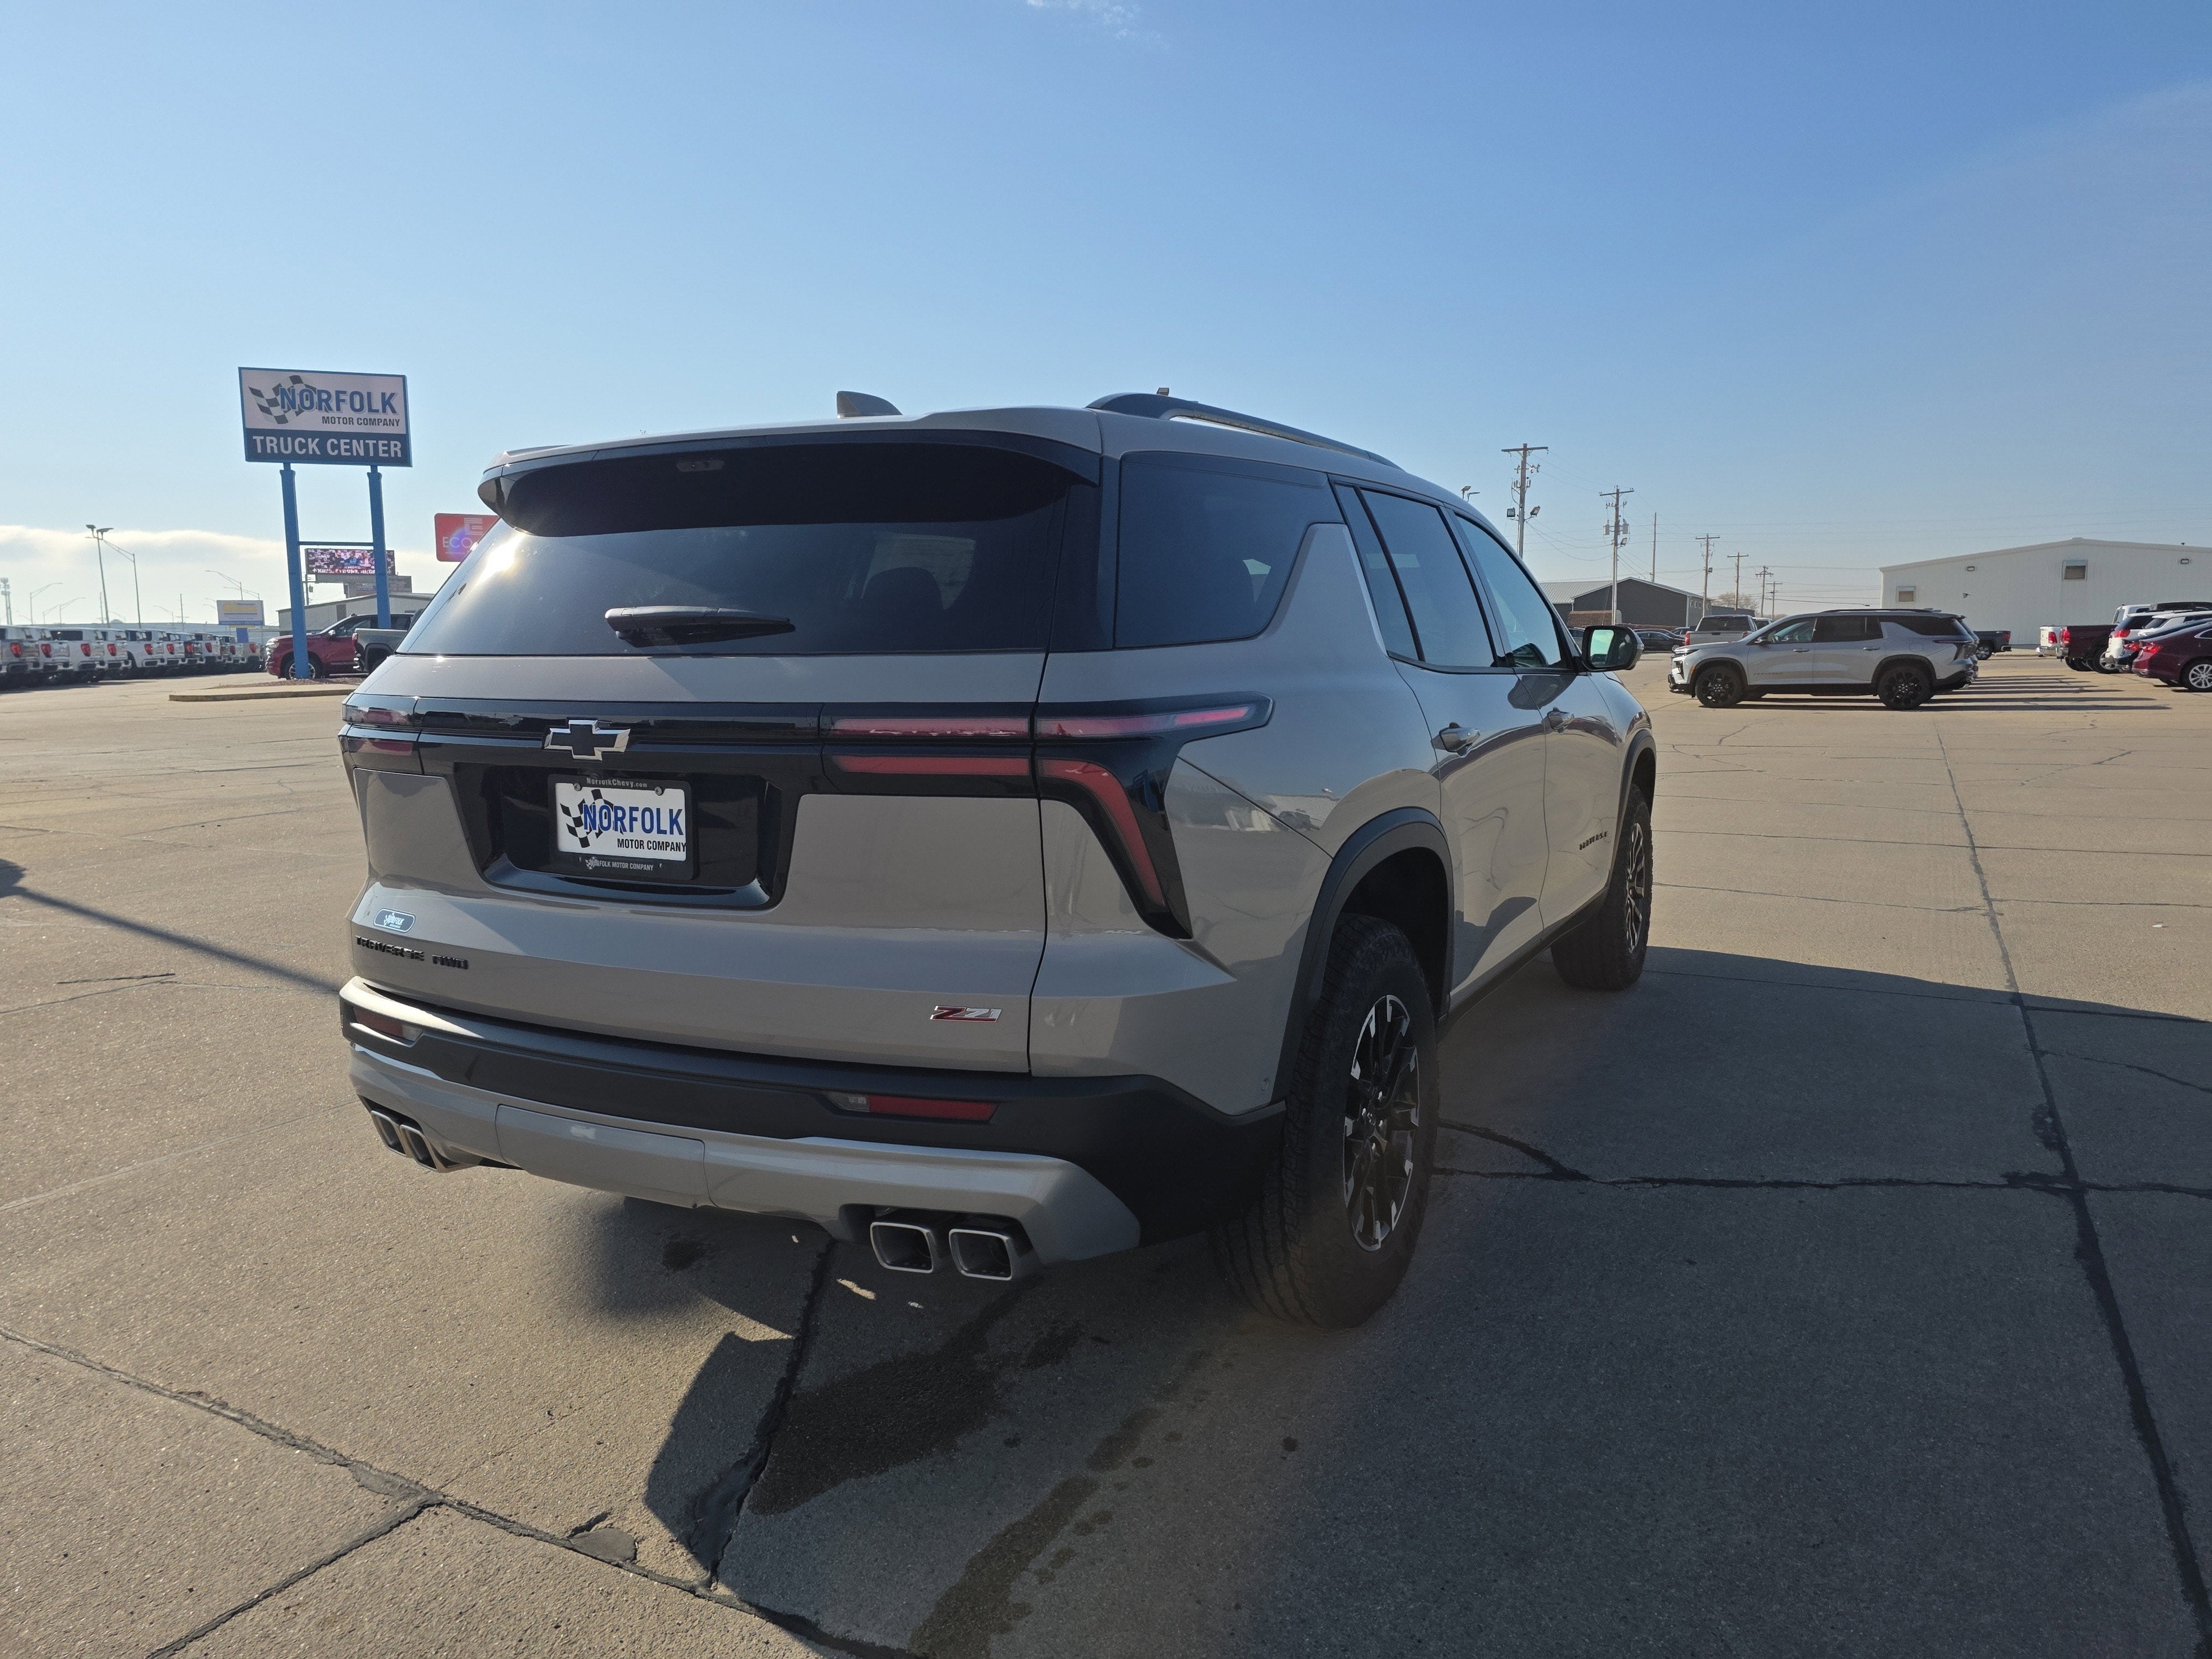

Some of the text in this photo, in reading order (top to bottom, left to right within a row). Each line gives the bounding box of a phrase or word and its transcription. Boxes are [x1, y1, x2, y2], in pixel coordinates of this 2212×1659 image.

[280, 387, 397, 414] NORFOLK
[322, 416, 400, 427] MOTOR COMPANY
[253, 435, 402, 458] TRUCK CENTER
[586, 777, 647, 788] NorfolkChevy.com
[583, 803, 684, 835] NORFOLK
[617, 838, 686, 852] MOTOR COMPANY
[629, 863, 654, 871] COMPANY
[355, 935, 468, 969] TRAVERSE AWD
[930, 1005, 1003, 1023] Z71
